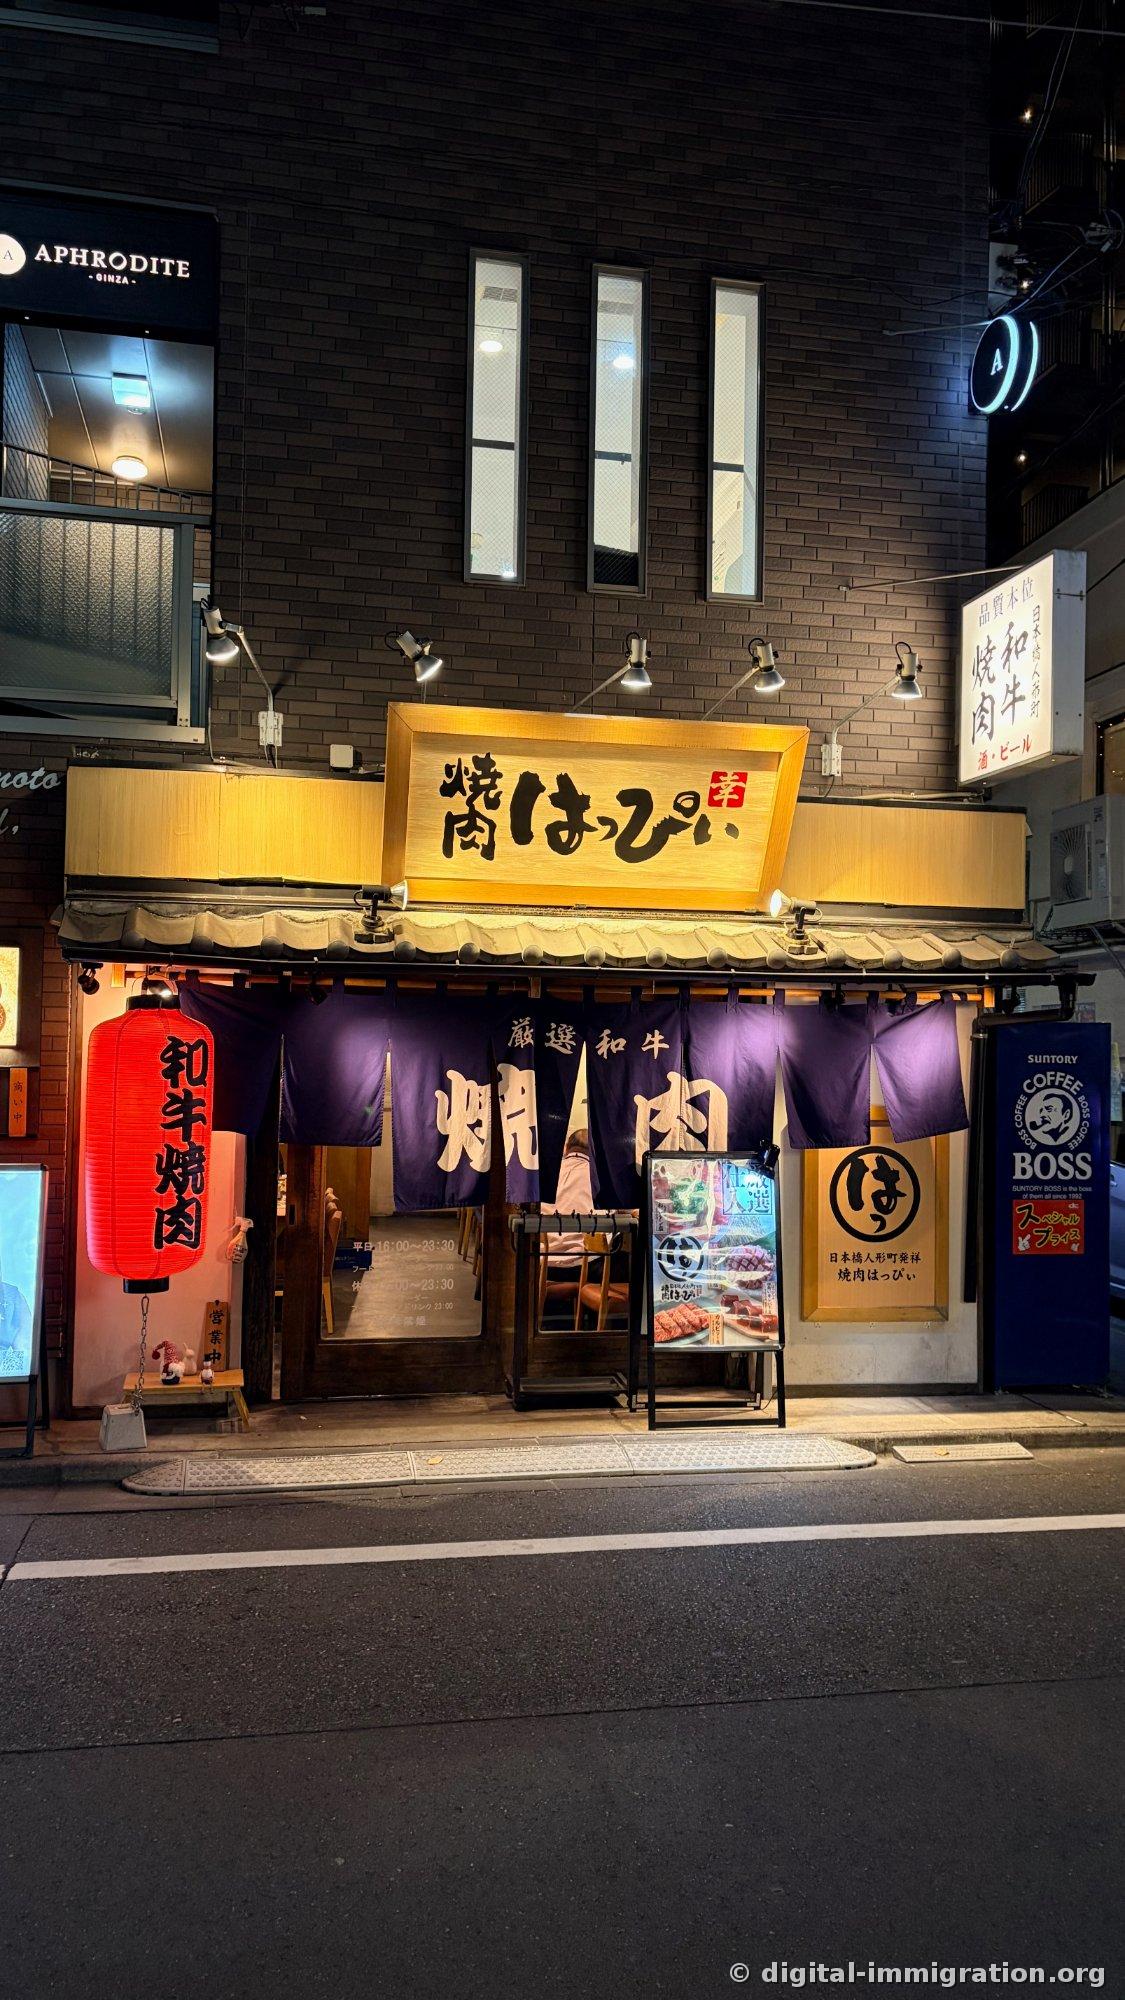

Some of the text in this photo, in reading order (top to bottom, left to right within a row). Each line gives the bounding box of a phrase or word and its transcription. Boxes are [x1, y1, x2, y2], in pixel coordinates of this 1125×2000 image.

[1, 249, 14, 262] A
[34, 243, 191, 279] APHRODITE
[990, 347, 1004, 376] A
[977, 576, 1035, 628] 品質本位
[970, 633, 997, 747] 焼肉
[1000, 620, 1029, 727] 和牛
[977, 733, 1033, 772] 酒・ビール
[439, 751, 504, 862] 焼肉
[709, 771, 748, 808] 幸
[508, 1016, 670, 1060] 厳選和牛
[1028, 1054, 1078, 1064] SUNTORY
[1023, 1071, 1084, 1095] COFFEE
[434, 1063, 728, 1175] 焼肉
[1015, 1094, 1037, 1150] BOSS COFFEE
[1068, 1095, 1091, 1150] BOSS COFFEE
[153, 1035, 209, 1250] 和牛焼肉
[1012, 1152, 1092, 1180] BOSS
[846, 1154, 908, 1233] はっ
[1016, 1202, 1081, 1230] スペシャル
[1034, 1226, 1081, 1248] プライス
[829, 1252, 922, 1264] 日本橋人形町発祥
[208, 1309, 225, 1365] 営業中
